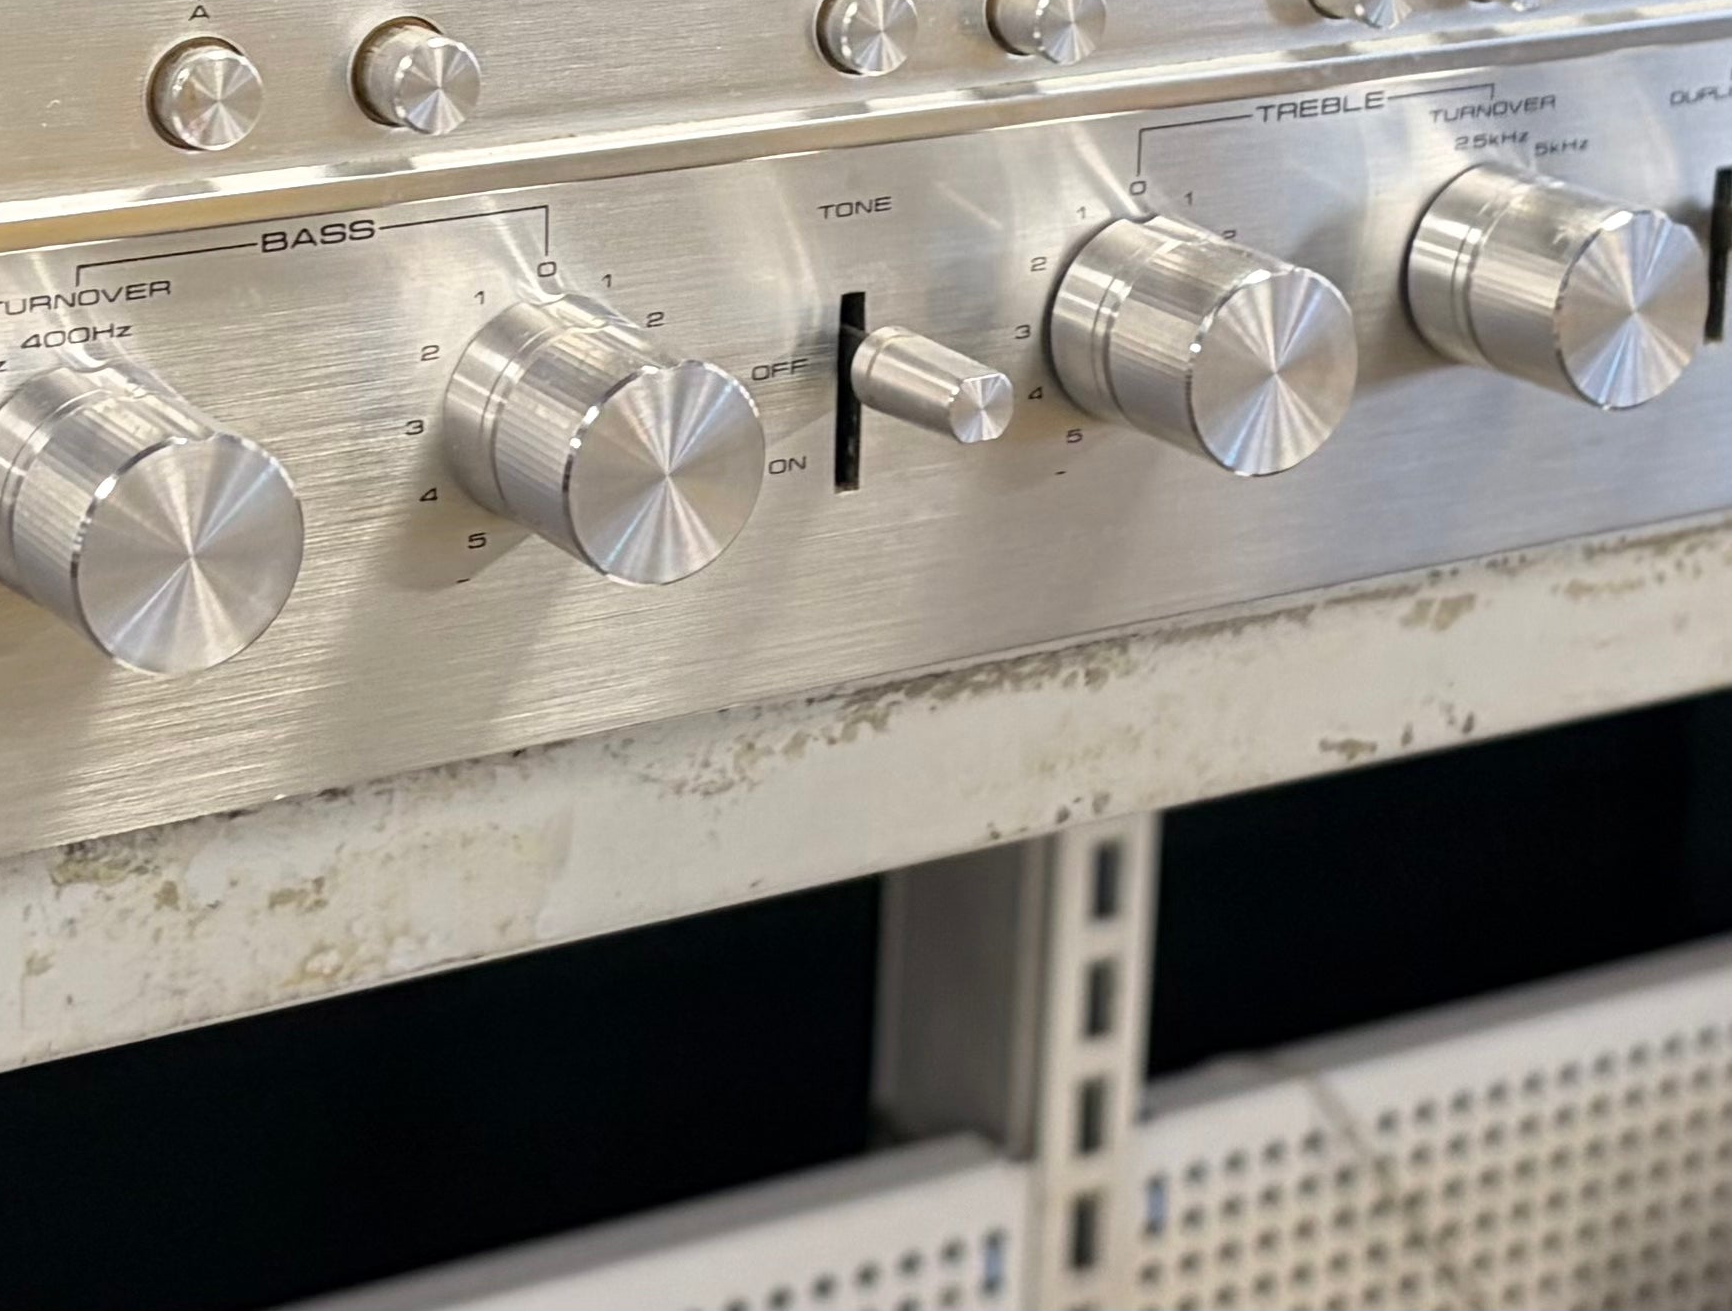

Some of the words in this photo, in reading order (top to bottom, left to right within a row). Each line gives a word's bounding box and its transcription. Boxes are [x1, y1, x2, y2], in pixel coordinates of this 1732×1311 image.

[190, 5, 211, 21] A
[1255, 90, 1387, 124] TREBLE
[1429, 95, 1556, 124] TURNOVER
[1184, 191, 1194, 206] 1
[818, 196, 893, 221] TONE
[1076, 206, 1088, 220] 1
[260, 219, 376, 254] BASS
[1030, 256, 1047, 272] 2
[601, 273, 614, 289] 1
[472, 290, 486, 306] 1
[646, 311, 666, 329] 2
[20, 322, 133, 351] 400Hz
[1014, 324, 1031, 340] 3
[419, 344, 441, 362] 2
[751, 357, 810, 382] OFF
[1027, 386, 1044, 401] 4
[403, 419, 425, 437] 3
[1066, 428, 1083, 444] 5
[767, 454, 808, 477] ON
[419, 486, 439, 503] 4
[467, 532, 487, 549] 5
